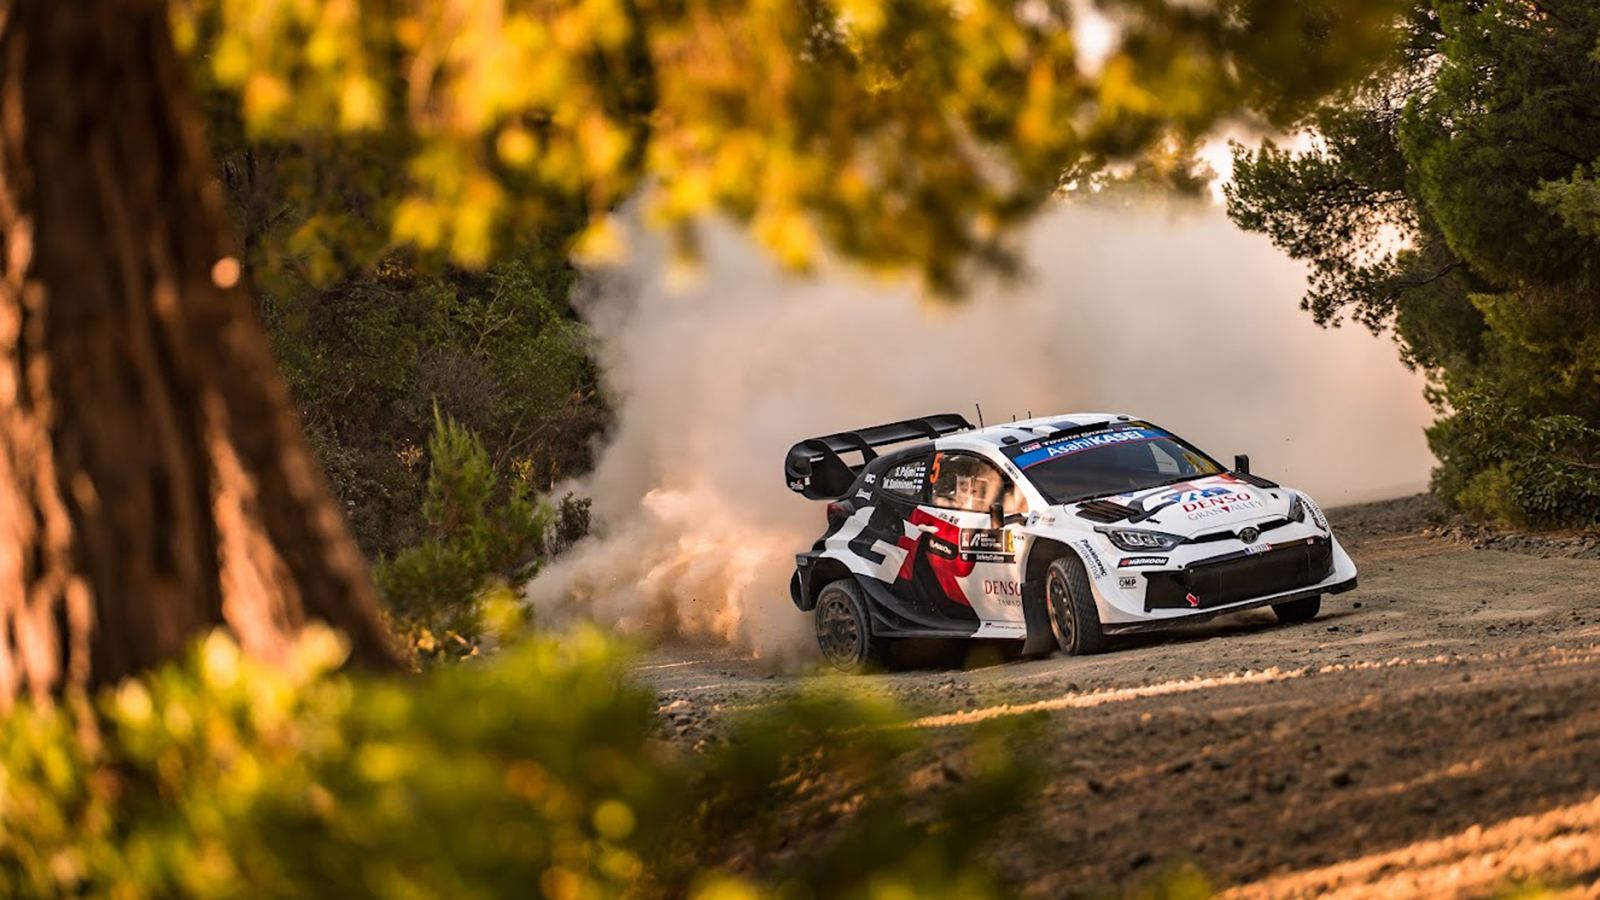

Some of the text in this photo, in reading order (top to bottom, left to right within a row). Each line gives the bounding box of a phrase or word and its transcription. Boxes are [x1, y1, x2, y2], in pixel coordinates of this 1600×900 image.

[930, 452, 945, 483] 5
[1182, 492, 1252, 513] DENSO
[1080, 539, 1108, 577] Panasonic
[1119, 579, 1137, 587] OMP
